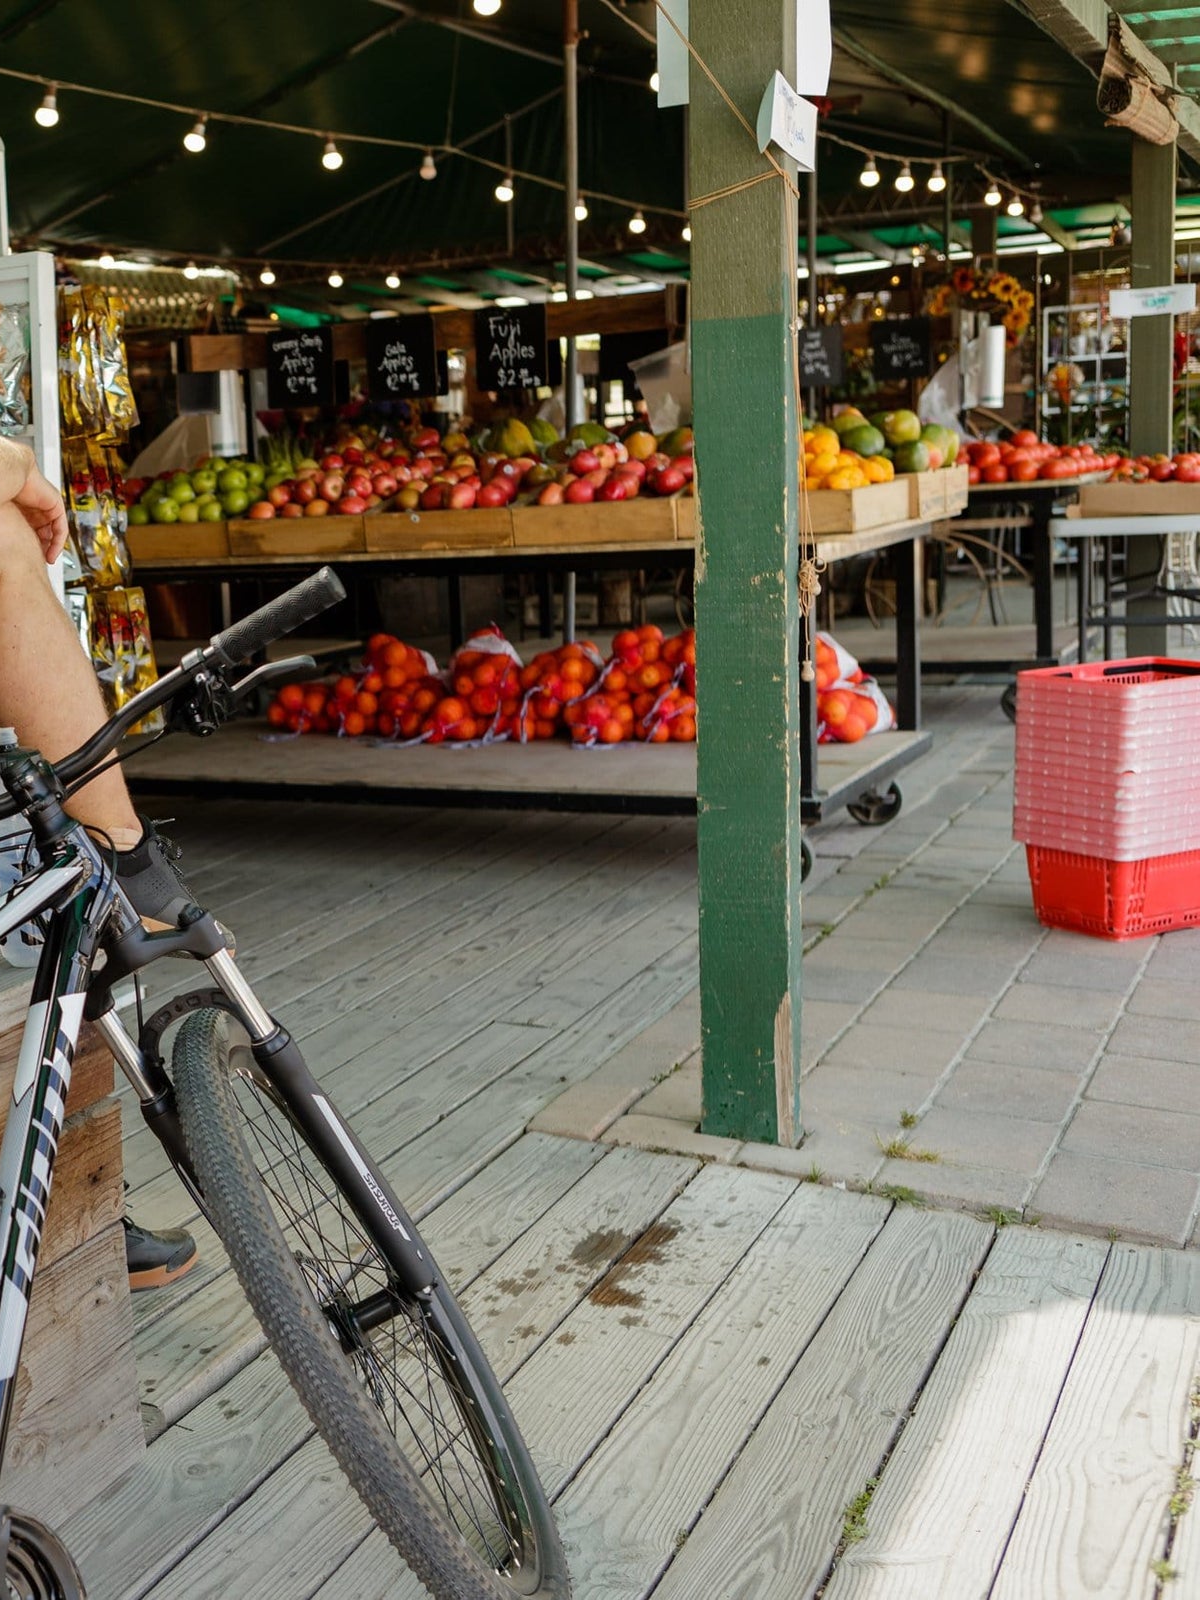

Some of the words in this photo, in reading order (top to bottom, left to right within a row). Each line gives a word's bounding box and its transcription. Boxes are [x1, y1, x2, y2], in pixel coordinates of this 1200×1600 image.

[488, 315, 521, 348] Fuji
[279, 354, 315, 375] Apples
[377, 355, 415, 373] Apples
[488, 342, 536, 368] Apples
[373, 1188, 400, 1228] SUNTOUR
